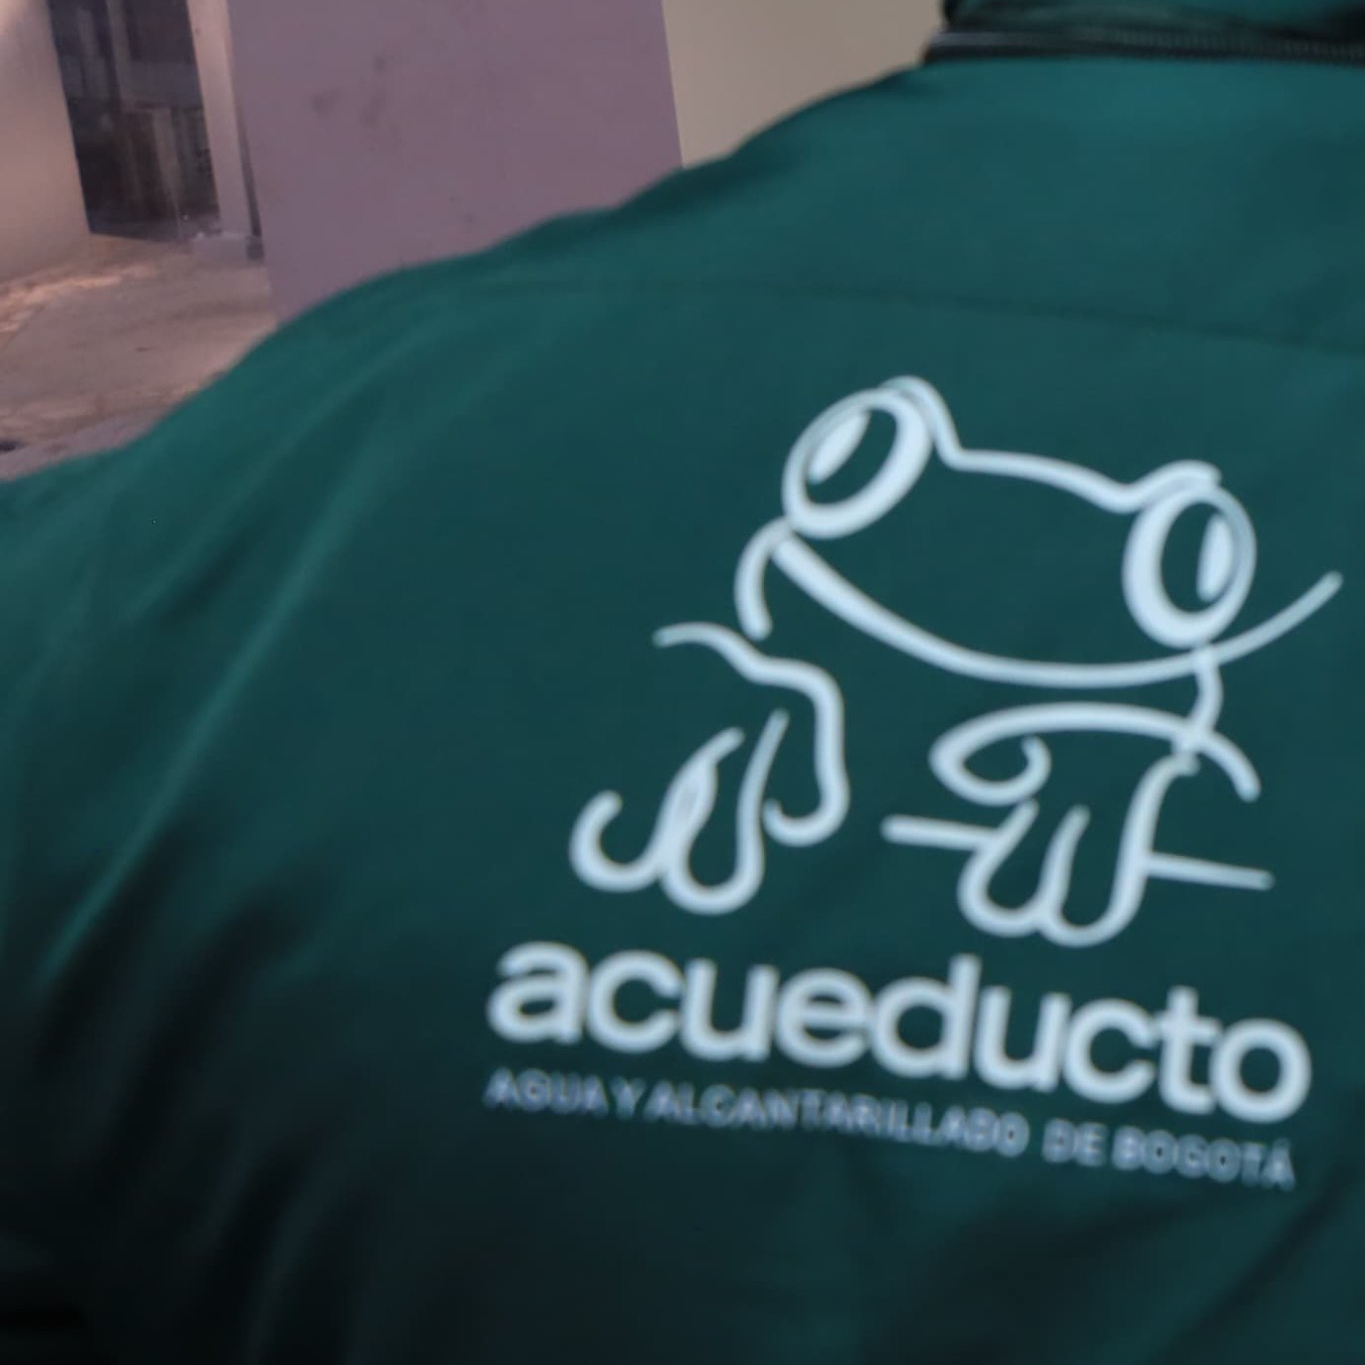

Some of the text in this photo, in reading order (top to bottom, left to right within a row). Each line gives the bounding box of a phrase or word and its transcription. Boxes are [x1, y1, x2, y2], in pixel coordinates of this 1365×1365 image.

[486, 939, 1313, 1123] acueducto
[484, 1066, 1296, 1190] AGUA Y ALCANTARILLADO DE BOGOTÁ
